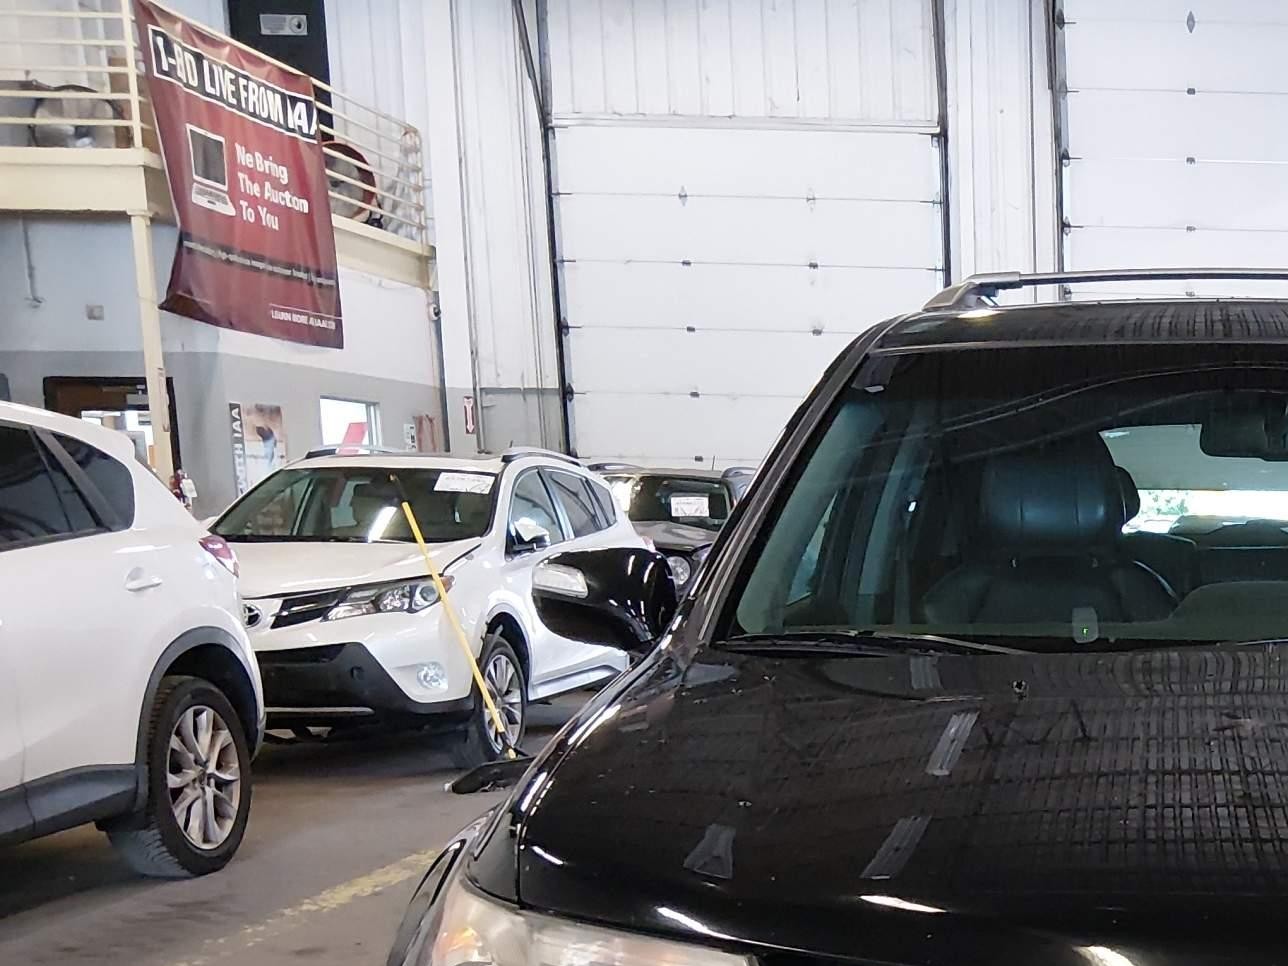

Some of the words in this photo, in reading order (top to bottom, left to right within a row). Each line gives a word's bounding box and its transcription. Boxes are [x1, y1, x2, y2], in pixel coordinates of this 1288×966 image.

[156, 36, 198, 87] I-BD
[203, 60, 236, 105] LIVE
[239, 77, 283, 125] FROM
[254, 152, 289, 184] Bring
[238, 172, 260, 197] The
[240, 200, 255, 222] To
[257, 205, 279, 230] You
[231, 407, 242, 437] IAA
